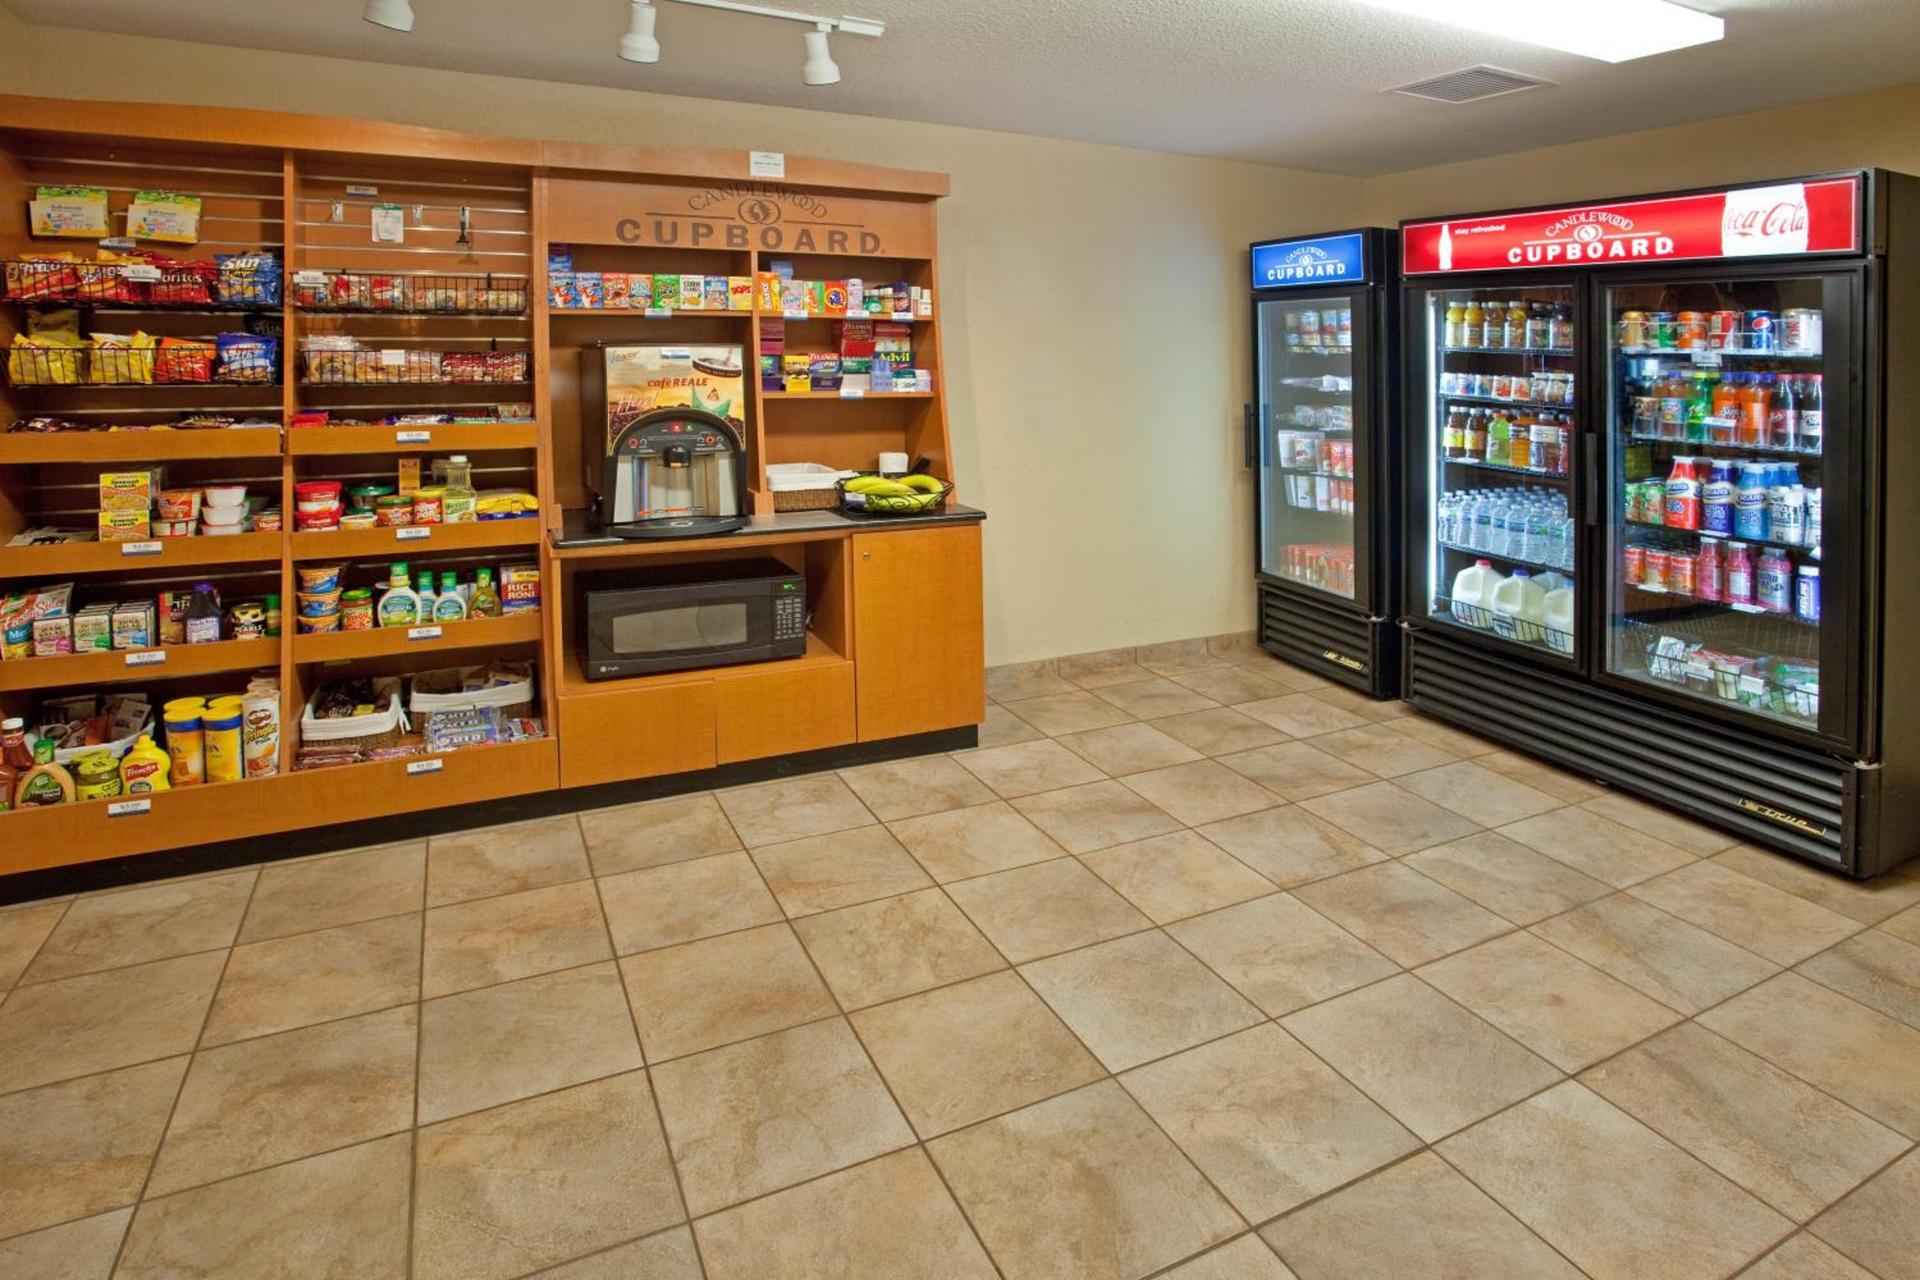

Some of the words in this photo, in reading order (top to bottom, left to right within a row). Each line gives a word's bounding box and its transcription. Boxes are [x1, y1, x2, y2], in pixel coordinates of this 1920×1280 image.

[687, 181, 828, 218] CANDLEWOOD
[1471, 224, 1506, 233] refreshed
[1545, 211, 1635, 236] CANDLEWOOD
[615, 218, 881, 254] CUPBOARD
[1508, 237, 1673, 263] CUPBOARD
[161, 273, 203, 283] oritos
[1267, 263, 1346, 280] CUPBOARD
[880, 353, 910, 362] Advil
